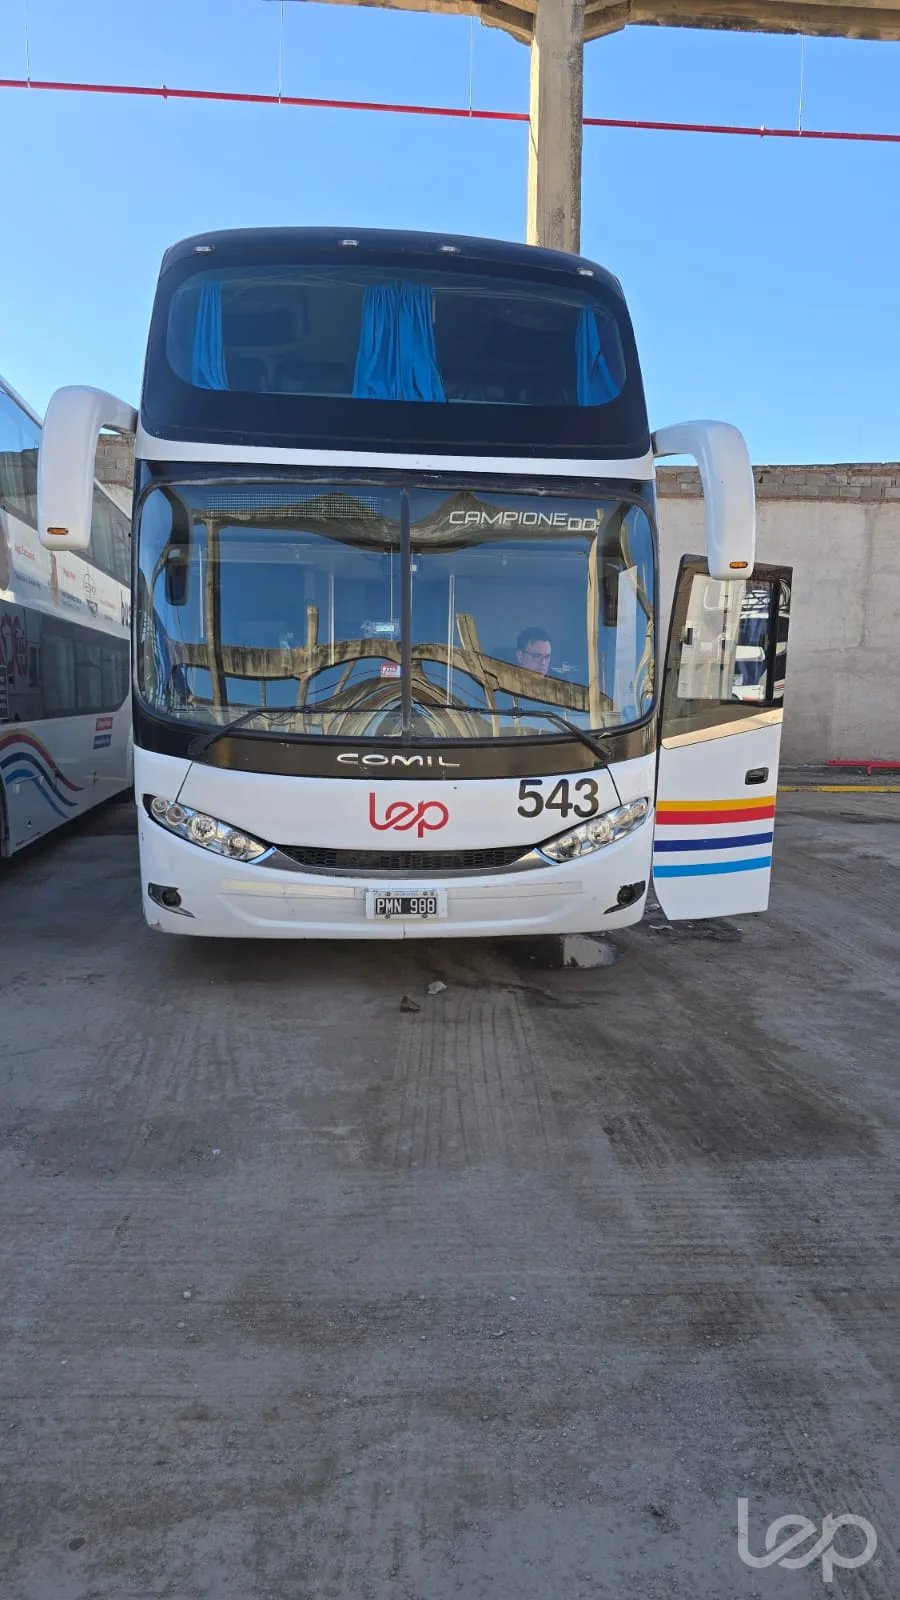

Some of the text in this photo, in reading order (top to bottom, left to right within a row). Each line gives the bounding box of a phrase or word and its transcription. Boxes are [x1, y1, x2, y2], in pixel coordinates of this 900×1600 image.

[449, 510, 568, 526] CAMPIONE
[337, 753, 460, 767] COMIL
[517, 778, 599, 818] 543
[376, 898, 435, 914] PMN 988
